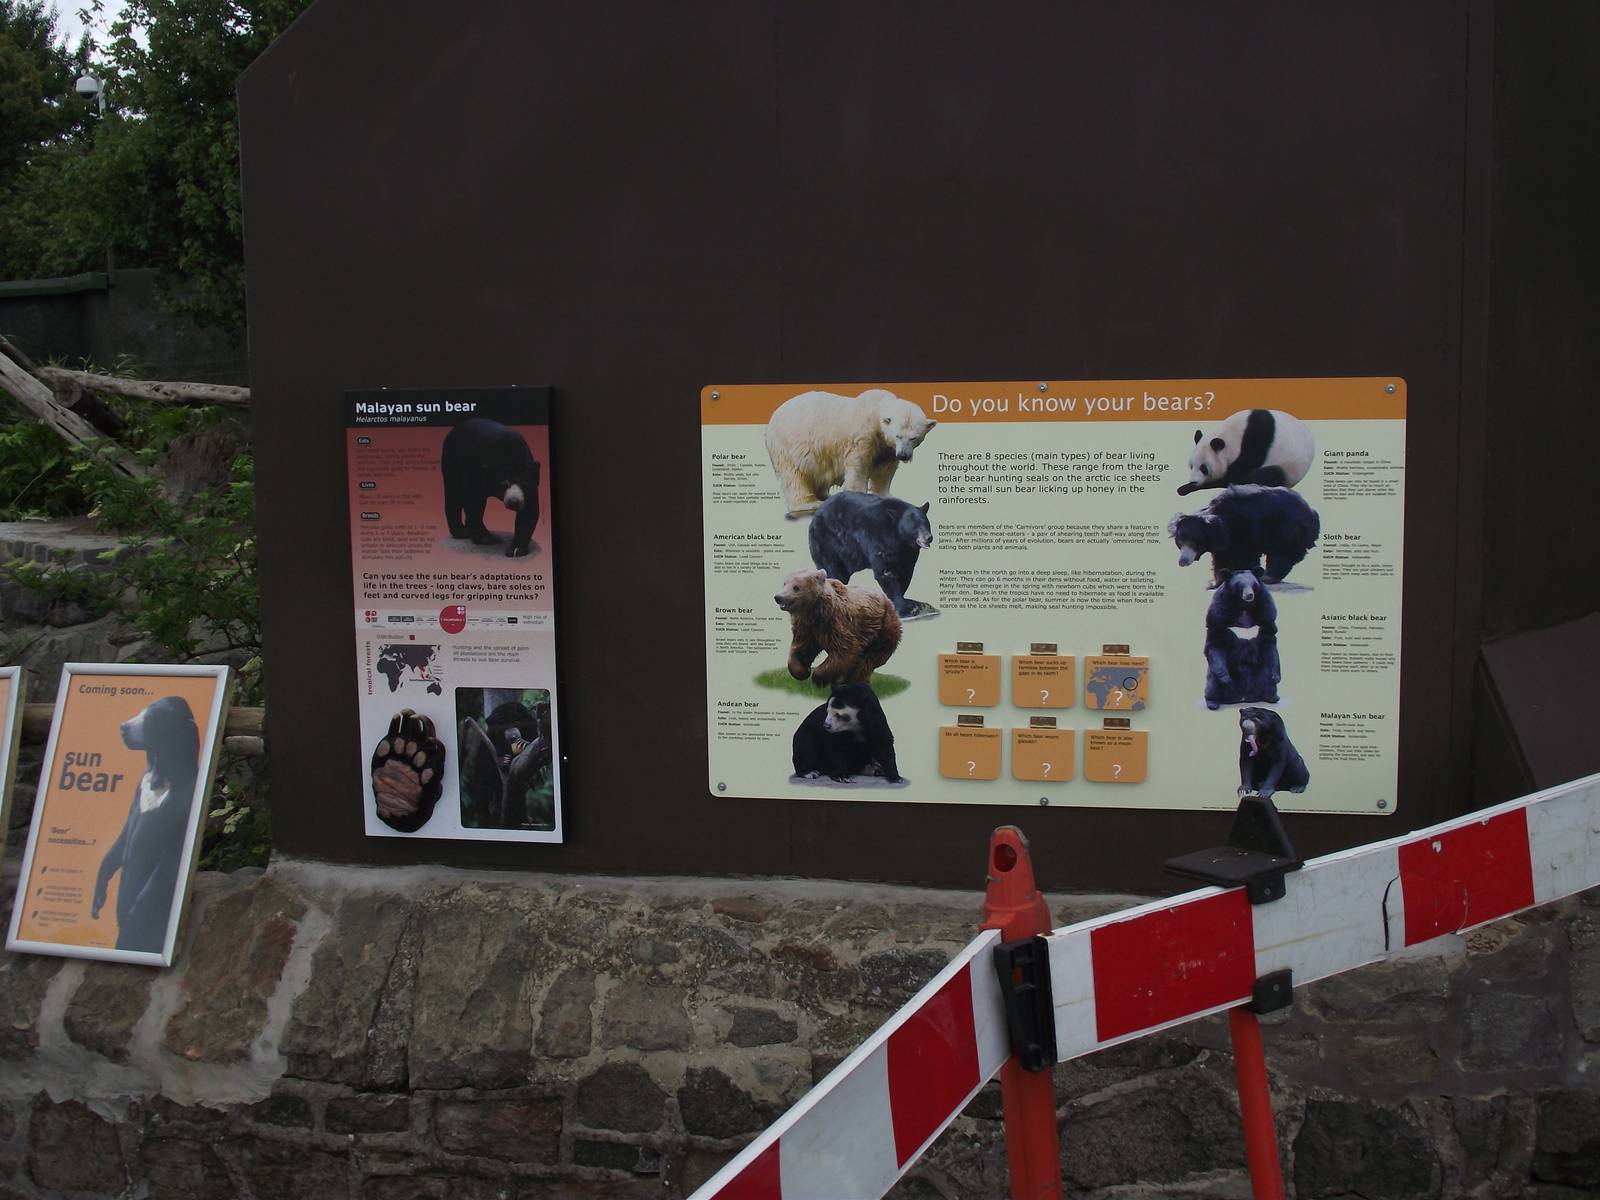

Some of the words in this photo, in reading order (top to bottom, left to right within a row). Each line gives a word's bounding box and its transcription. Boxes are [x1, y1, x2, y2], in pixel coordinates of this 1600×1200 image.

[356, 401, 411, 416] Malayan
[417, 403, 440, 412] sun
[446, 400, 476, 412] bear
[934, 394, 961, 413] Do
[970, 398, 1008, 416] you
[1019, 390, 1076, 412] know
[1085, 397, 1134, 415] your
[1144, 391, 1214, 411] bears?
[388, 415, 427, 423] malayanus
[938, 452, 964, 461] There
[985, 452, 991, 460] 8
[994, 453, 1028, 461] species
[1031, 452, 1058, 462] (main
[1061, 452, 1090, 461] types)
[1094, 451, 1103, 460] of
[1130, 452, 1155, 461] living
[938, 463, 989, 473] throughout
[992, 463, 1007, 471] the
[1009, 463, 1039, 471] world.
[1042, 462, 1069, 471] These
[1072, 464, 1099, 473] range
[1102, 462, 1124, 471] from
[1127, 462, 1142, 471] the
[1145, 462, 1170, 472] large
[938, 474, 962, 484] polar
[964, 473, 985, 482] bear
[987, 474, 1022, 484] hunting
[1129, 474, 1161, 482] sheets
[951, 485, 965, 494] the
[1015, 485, 1036, 493] bear
[1039, 485, 1068, 495] licking
[1086, 484, 1115, 494] honey
[1130, 485, 1144, 493] the
[938, 496, 992, 504] rainforests.
[480, 573, 531, 582] adaptations
[436, 582, 455, 592] long
[457, 583, 485, 591] claws,
[509, 583, 532, 591] soles
[432, 592, 450, 600] legs
[467, 592, 503, 602] gripping
[79, 684, 117, 697] Coming
[120, 686, 154, 696] soon...
[966, 688, 975, 704] ?
[1040, 690, 1049, 705] ?
[1114, 690, 1123, 706] ?
[65, 750, 102, 768] sun
[967, 761, 976, 776] ?
[1042, 762, 1051, 778] ?
[1112, 764, 1122, 779] ?
[59, 763, 124, 793] bear
